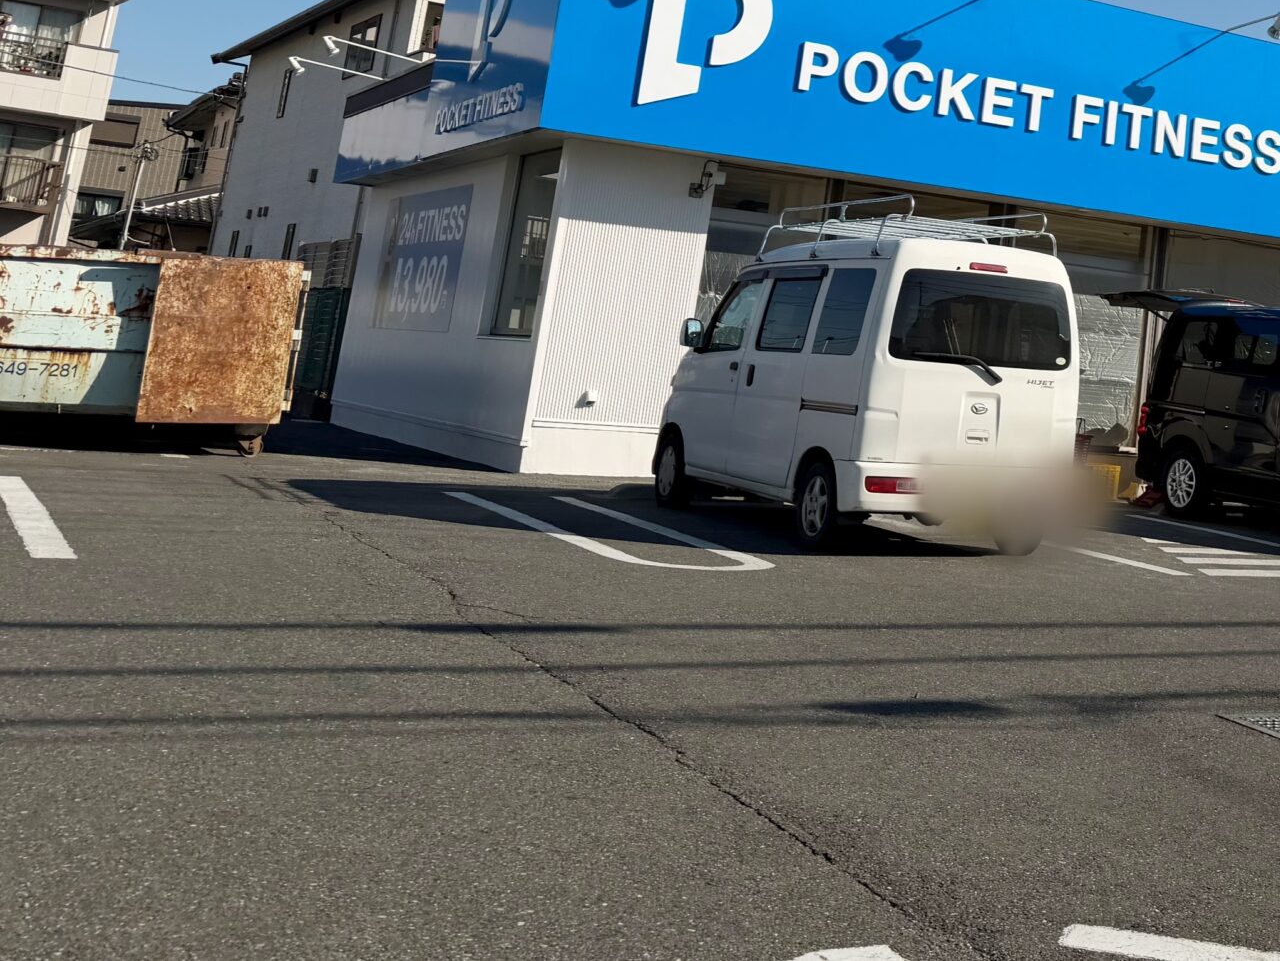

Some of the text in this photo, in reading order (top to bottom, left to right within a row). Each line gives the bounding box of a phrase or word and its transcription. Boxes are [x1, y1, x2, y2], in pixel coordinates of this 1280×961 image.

[434, 82, 524, 134] POCKET FITNESS
[797, 40, 1055, 132] POCKET
[1026, 378, 1056, 386] HIJET
